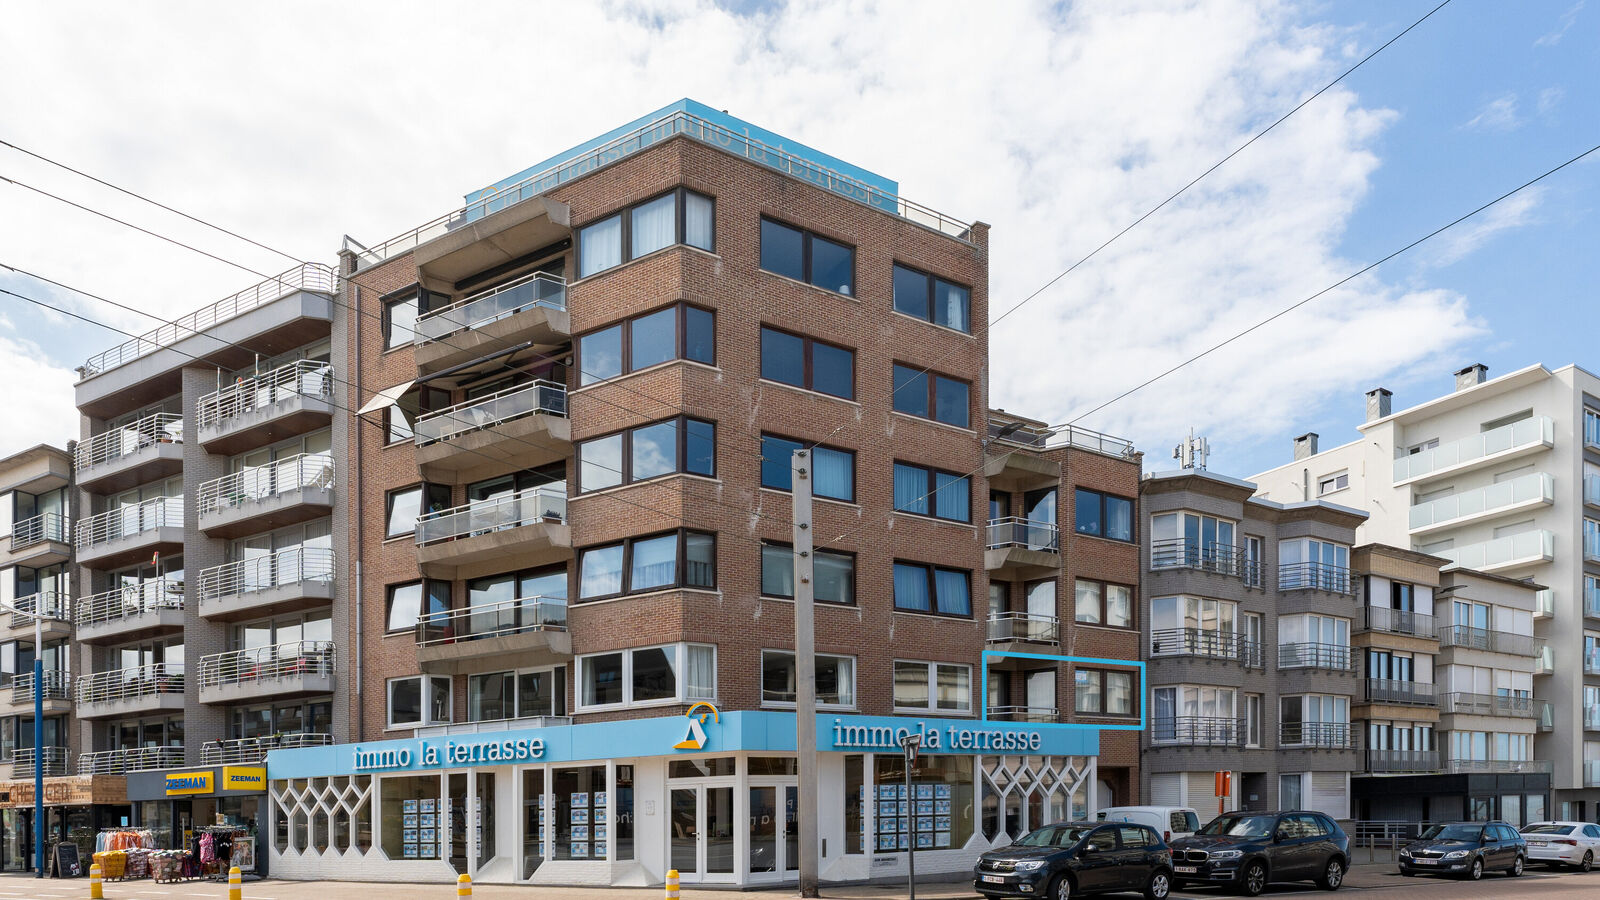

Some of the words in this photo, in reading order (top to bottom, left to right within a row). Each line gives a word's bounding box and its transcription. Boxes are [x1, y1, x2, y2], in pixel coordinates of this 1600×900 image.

[833, 718, 911, 748] immo
[917, 722, 941, 749] la
[949, 725, 1041, 751] terrasse
[352, 746, 411, 770] immo
[418, 740, 440, 766] la
[445, 737, 545, 764] terrasse
[166, 777, 206, 790] ZEEMAN
